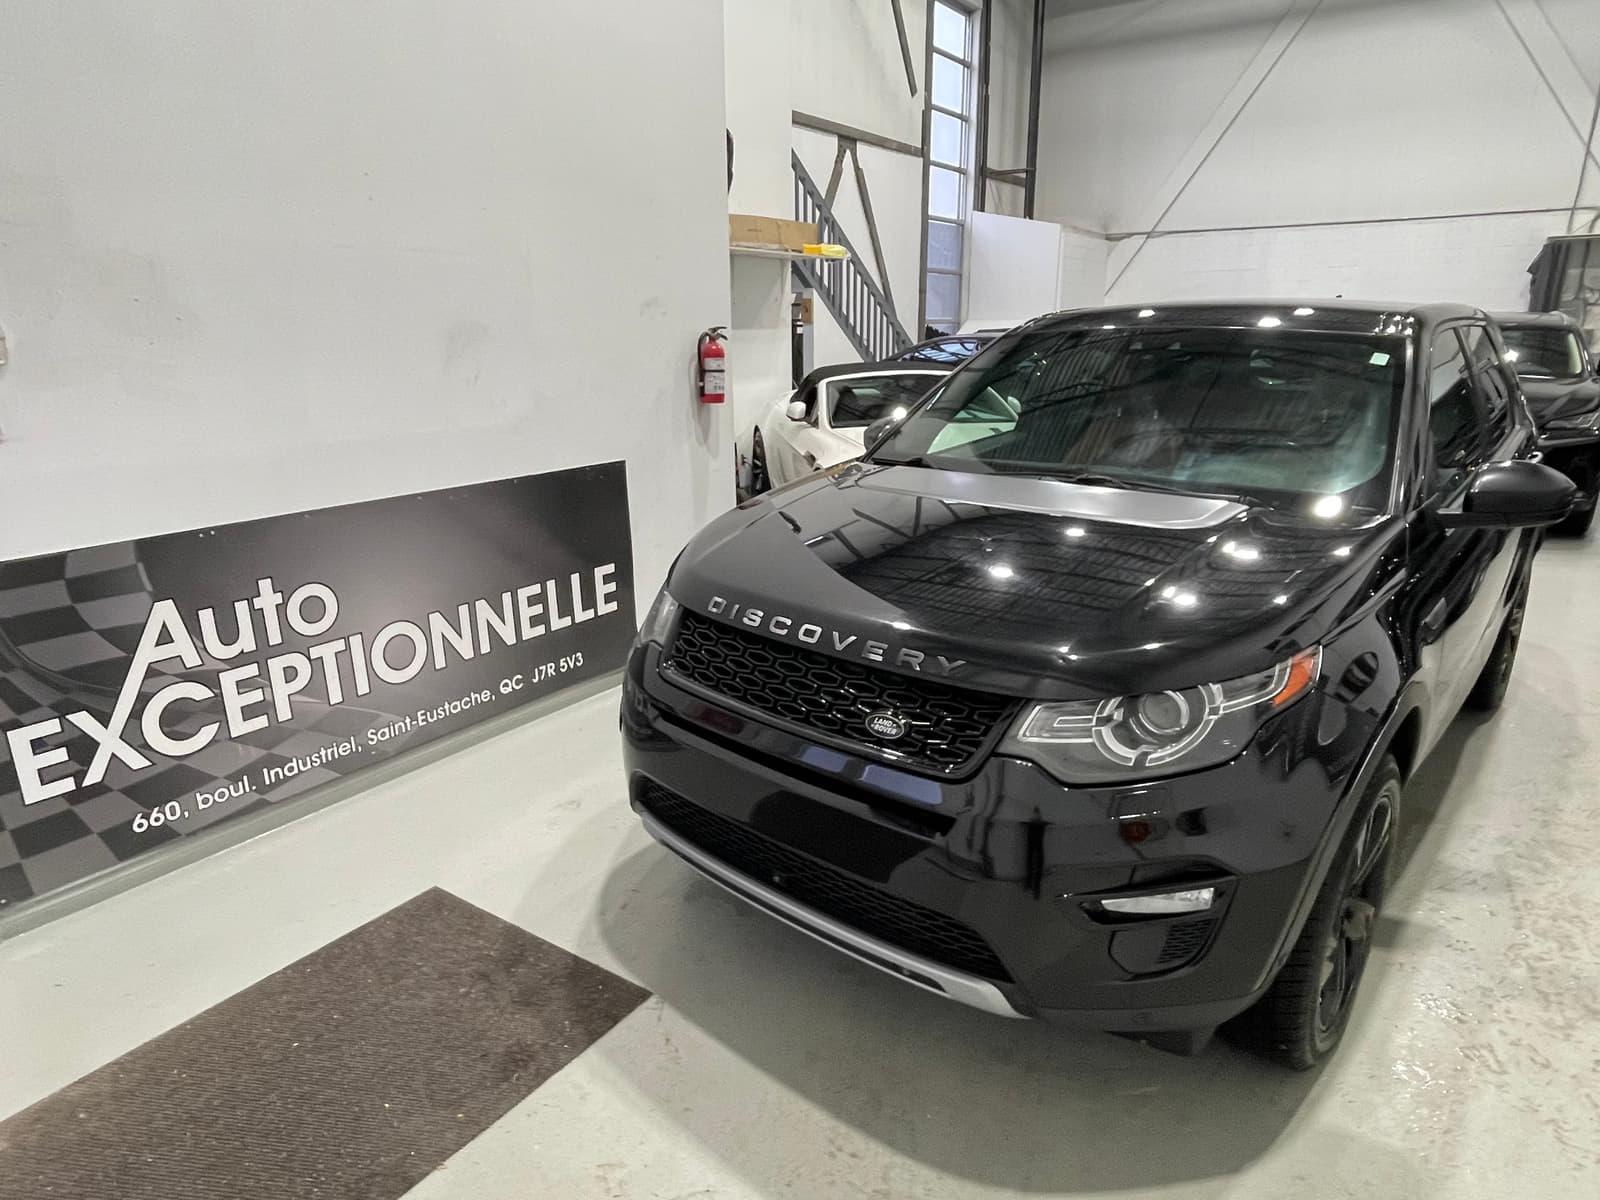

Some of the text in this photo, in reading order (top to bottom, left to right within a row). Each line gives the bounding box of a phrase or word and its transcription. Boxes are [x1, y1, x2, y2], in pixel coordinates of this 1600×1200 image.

[128, 577, 339, 670] Auto
[707, 595, 966, 675] DISCOVERY
[6, 563, 618, 805] EXCEPTIONNELLE
[873, 717, 893, 728] LAND
[132, 652, 584, 833] 660, boul. Industriel, Saint-Eustache, QC J7R 5V3
[873, 723, 897, 736] ROVER
